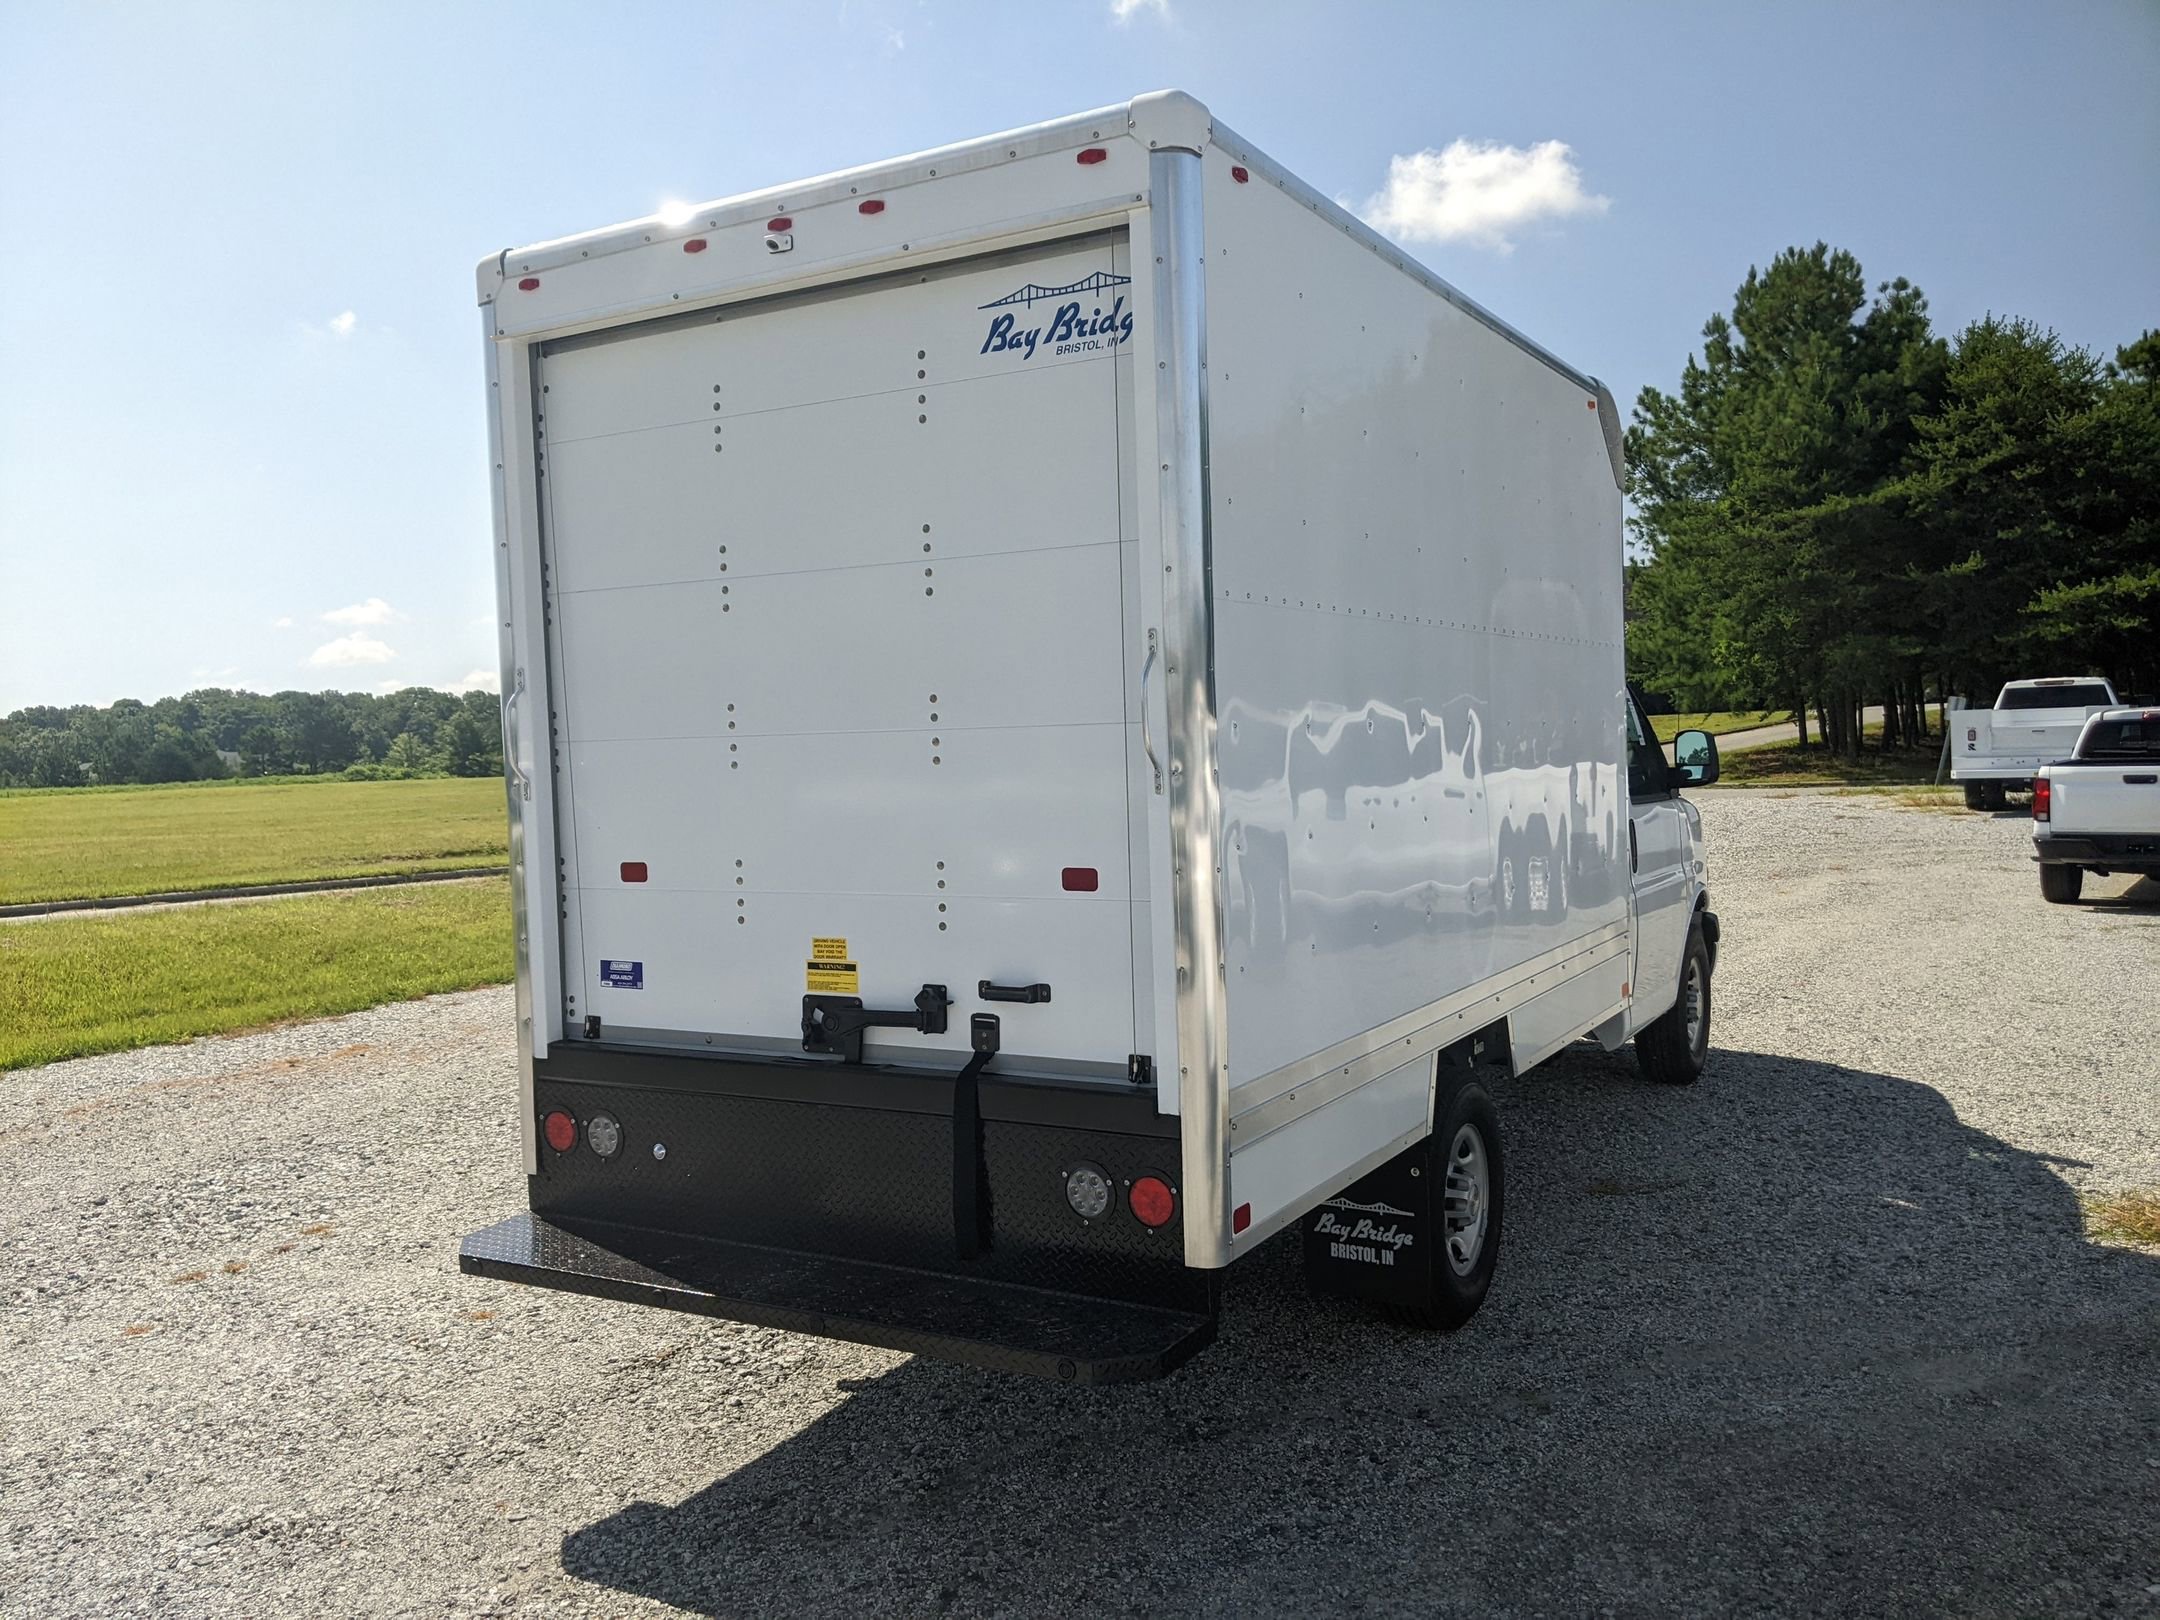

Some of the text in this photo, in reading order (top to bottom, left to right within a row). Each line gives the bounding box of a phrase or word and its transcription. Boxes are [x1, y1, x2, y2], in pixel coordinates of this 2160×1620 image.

[980, 296, 1133, 360] Bay Bridg
[1056, 336, 1119, 355] BRISTOL, IN
[1314, 1213, 1414, 1250] Bay Bridge
[1330, 1242, 1394, 1266] BRISTOL, IN
